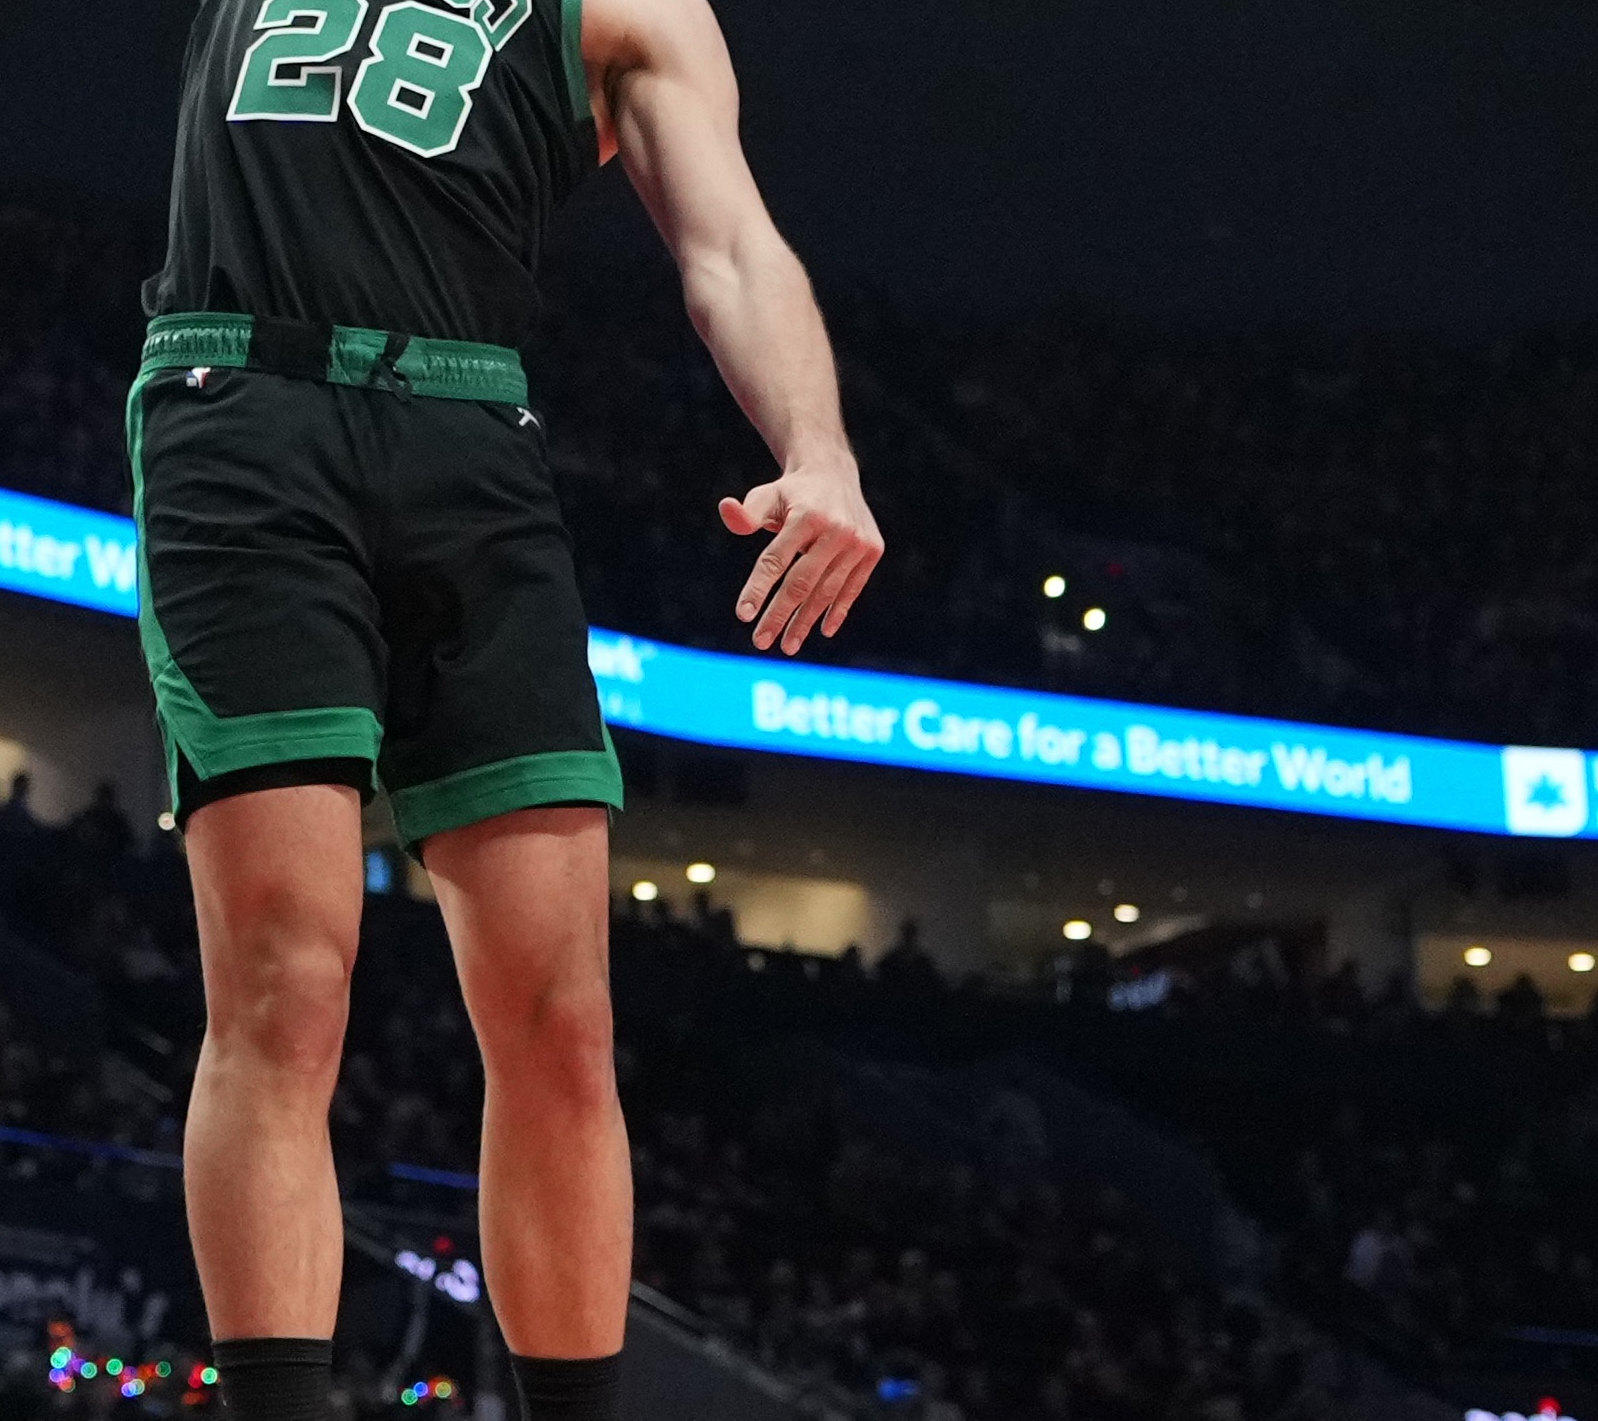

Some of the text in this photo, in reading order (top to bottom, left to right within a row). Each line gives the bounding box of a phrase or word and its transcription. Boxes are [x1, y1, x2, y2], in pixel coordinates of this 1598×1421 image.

[754, 682, 1410, 801] Better Care for a Better World
